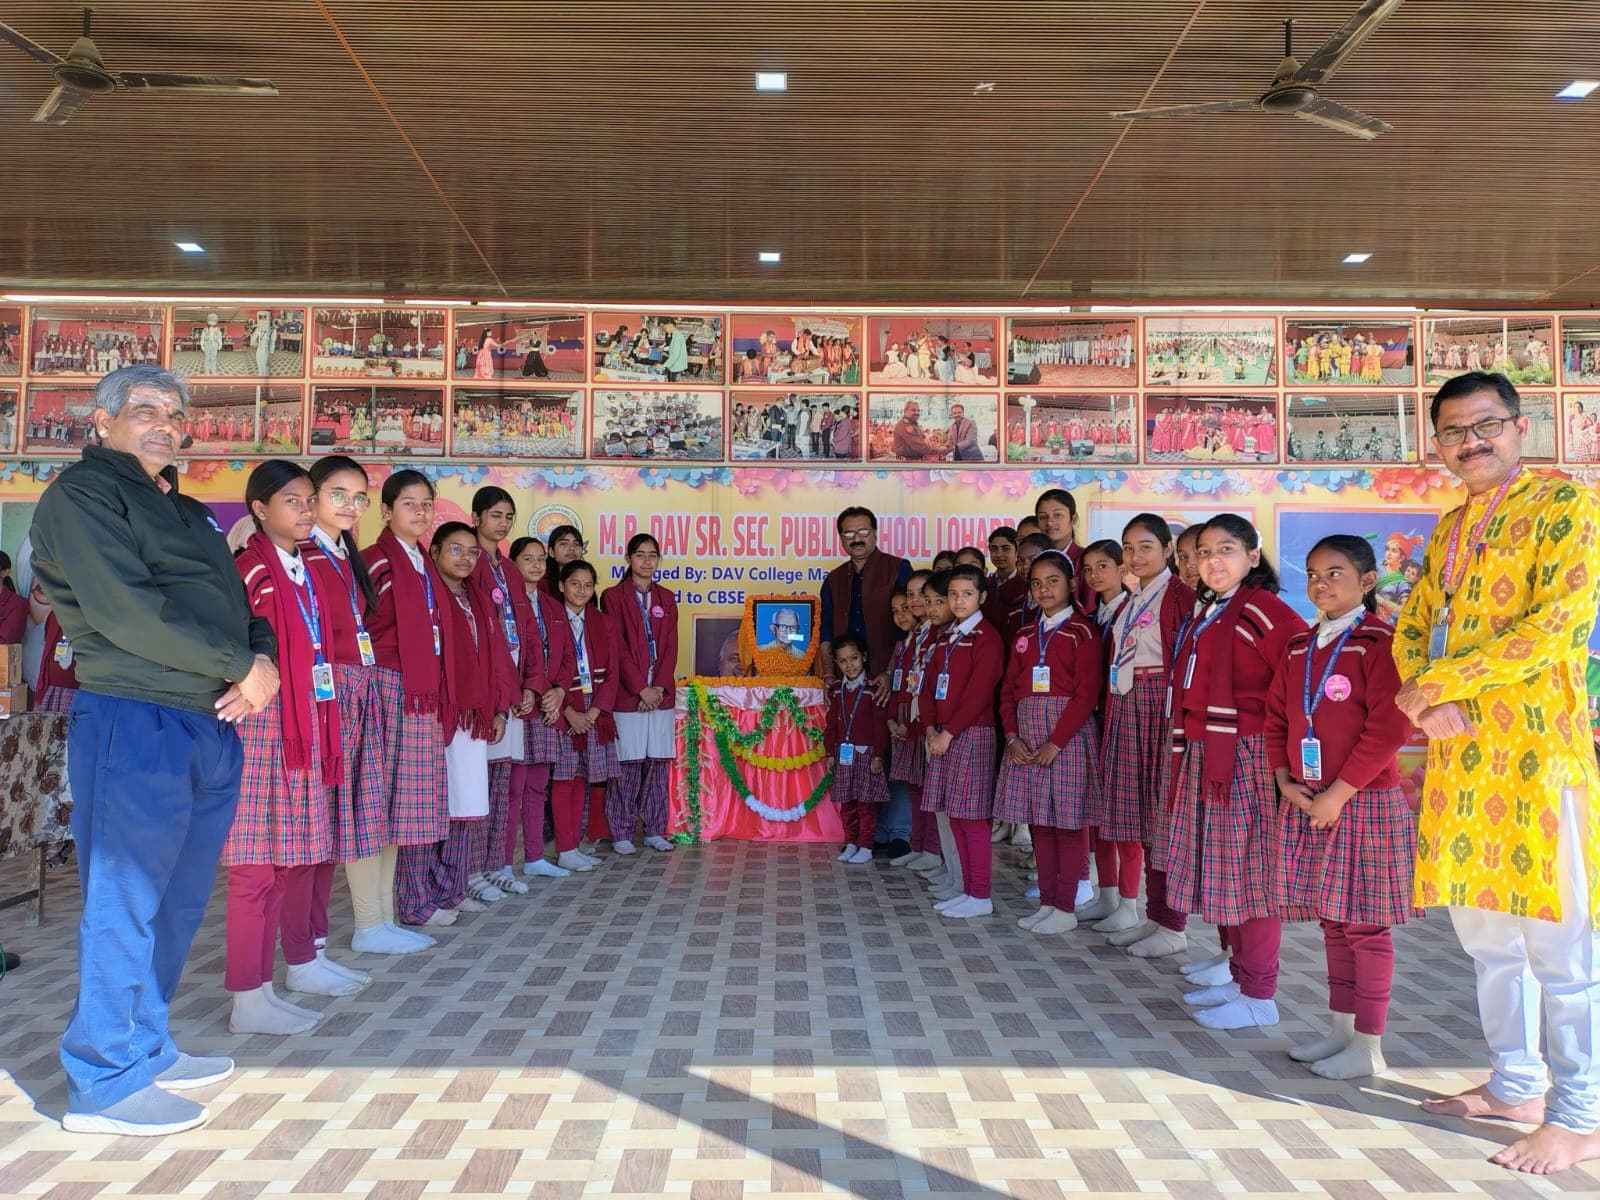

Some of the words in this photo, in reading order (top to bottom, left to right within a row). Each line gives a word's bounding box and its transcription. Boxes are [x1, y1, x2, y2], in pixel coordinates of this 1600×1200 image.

[650, 514, 691, 556] DAV
[694, 514, 728, 557] SR.
[732, 515, 775, 557] SEC.
[780, 515, 850, 558] PUBLI
[879, 516, 931, 559] HOOL
[611, 565, 680, 583] Mged
[685, 566, 707, 584] By:
[712, 567, 744, 581] DAV
[749, 567, 803, 585] College
[686, 592, 702, 604] to
[707, 590, 745, 605] CBSE
